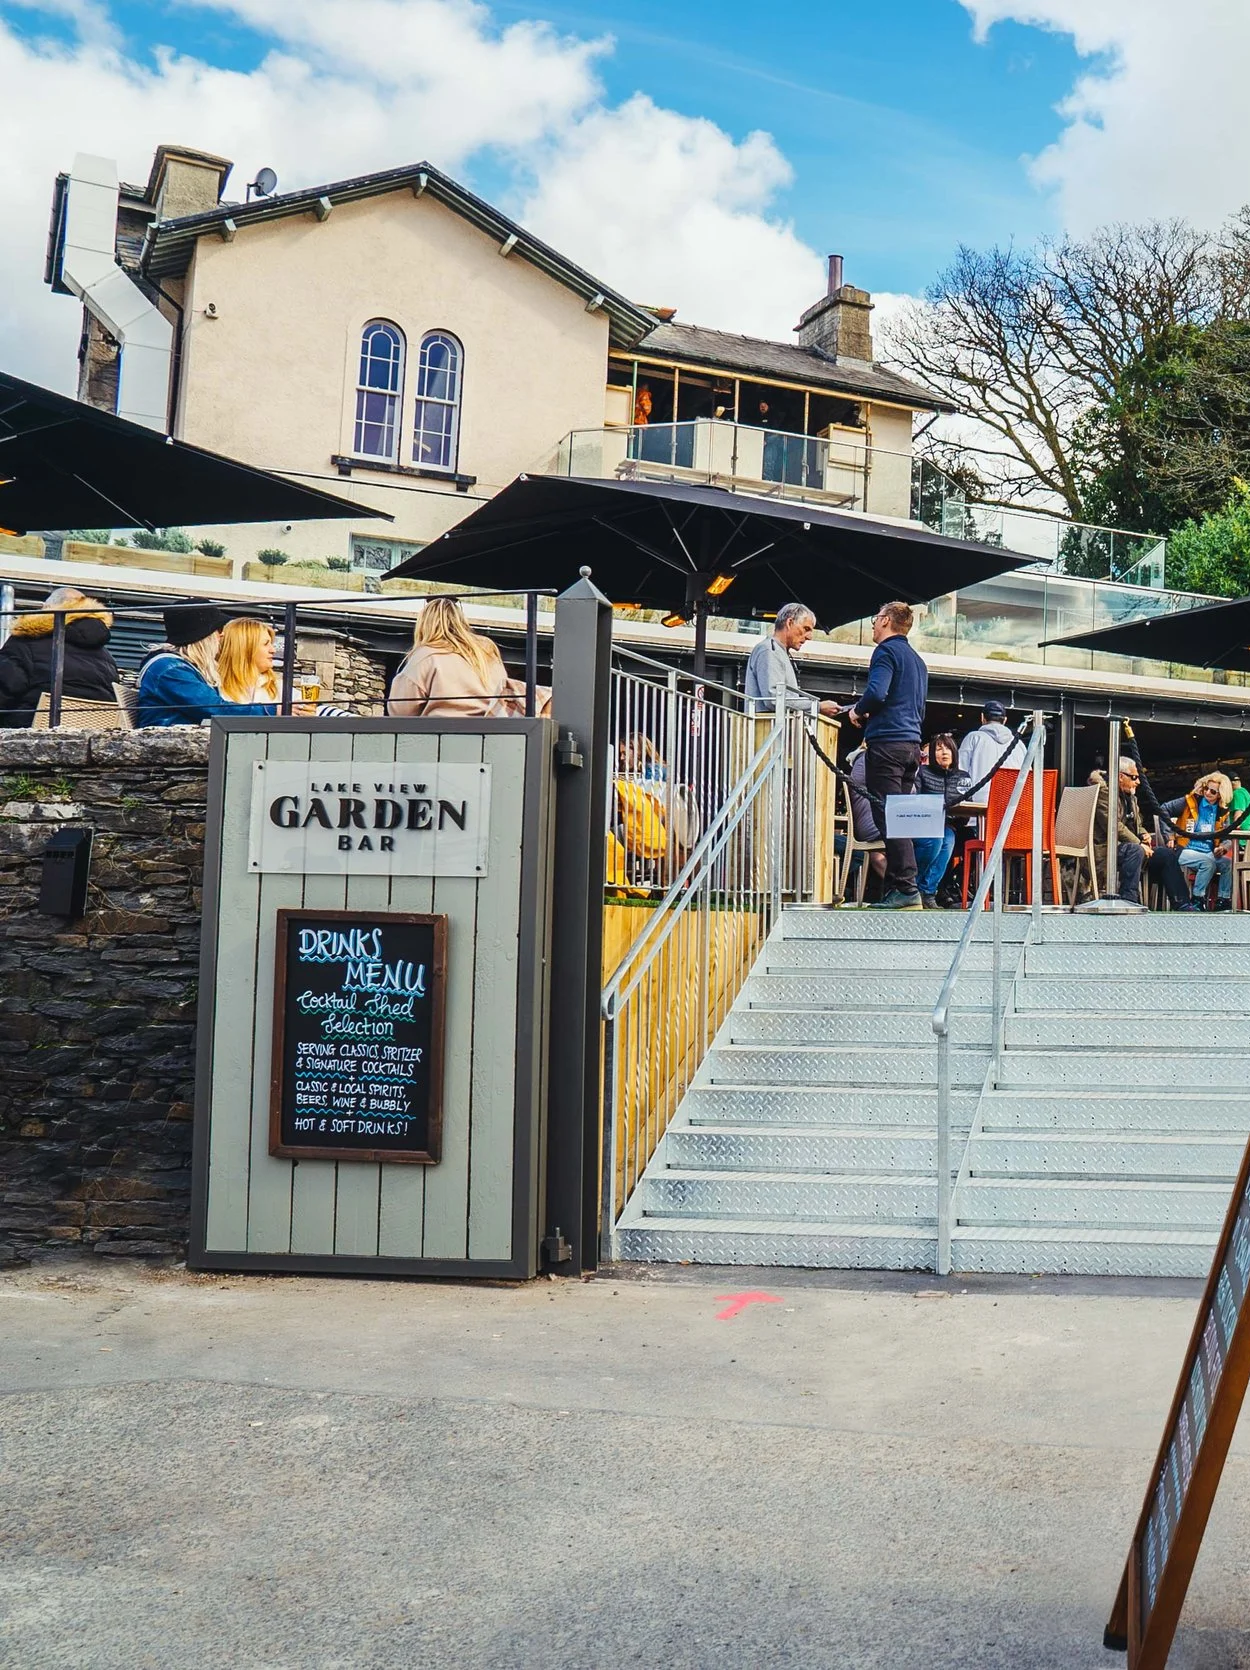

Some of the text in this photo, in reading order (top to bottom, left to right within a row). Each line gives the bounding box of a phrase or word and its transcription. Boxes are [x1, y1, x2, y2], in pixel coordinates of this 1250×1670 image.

[311, 782, 428, 794] LAKE VIEW
[270, 796, 466, 830] GARDEN
[338, 835, 394, 851] BAR
[299, 928, 383, 960] DRINKS
[345, 960, 426, 991] MENU
[297, 991, 414, 1017] Cocktail Shed
[321, 1013, 394, 1035] Selection
[297, 1042, 336, 1056] SERVING
[382, 1045, 422, 1063] SPRITZER
[296, 1056, 414, 1077] & SIGNATURE COCKTAILS
[296, 1081, 406, 1099] CLASSIC & LOCAL SPIRITS,
[296, 1093, 411, 1113] BEERS, WINE & BUBBLY
[295, 1117, 316, 1131] HOT
[319, 1119, 327, 1132] &
[330, 1119, 356, 1133] SOFT
